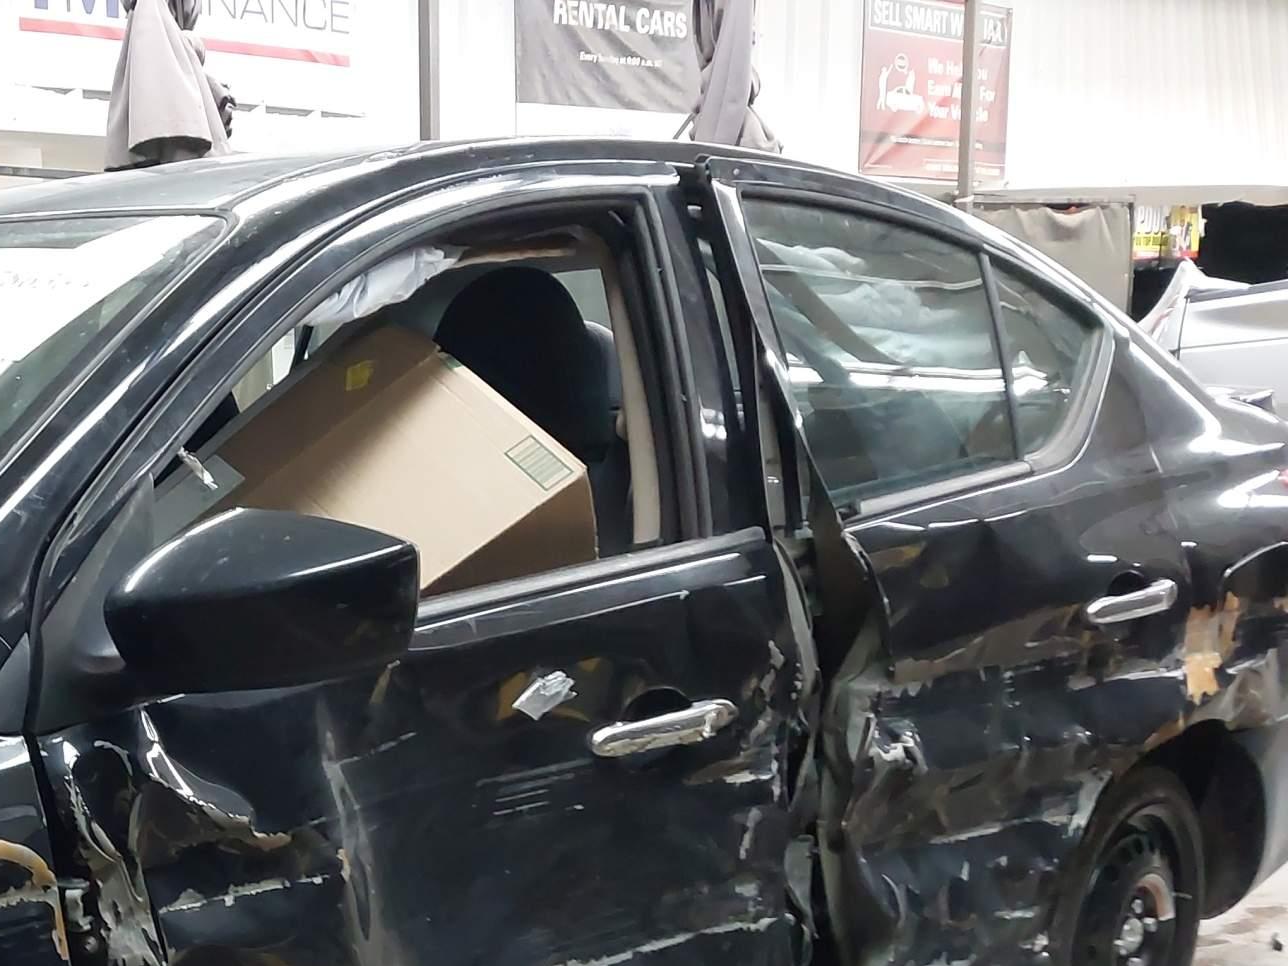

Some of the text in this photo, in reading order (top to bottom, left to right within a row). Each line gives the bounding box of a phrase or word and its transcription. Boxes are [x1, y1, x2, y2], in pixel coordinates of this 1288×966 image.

[553, 0, 688, 38] RENTAL CARS
[873, 0, 902, 27] SELL
[904, 5, 949, 34] SMART
